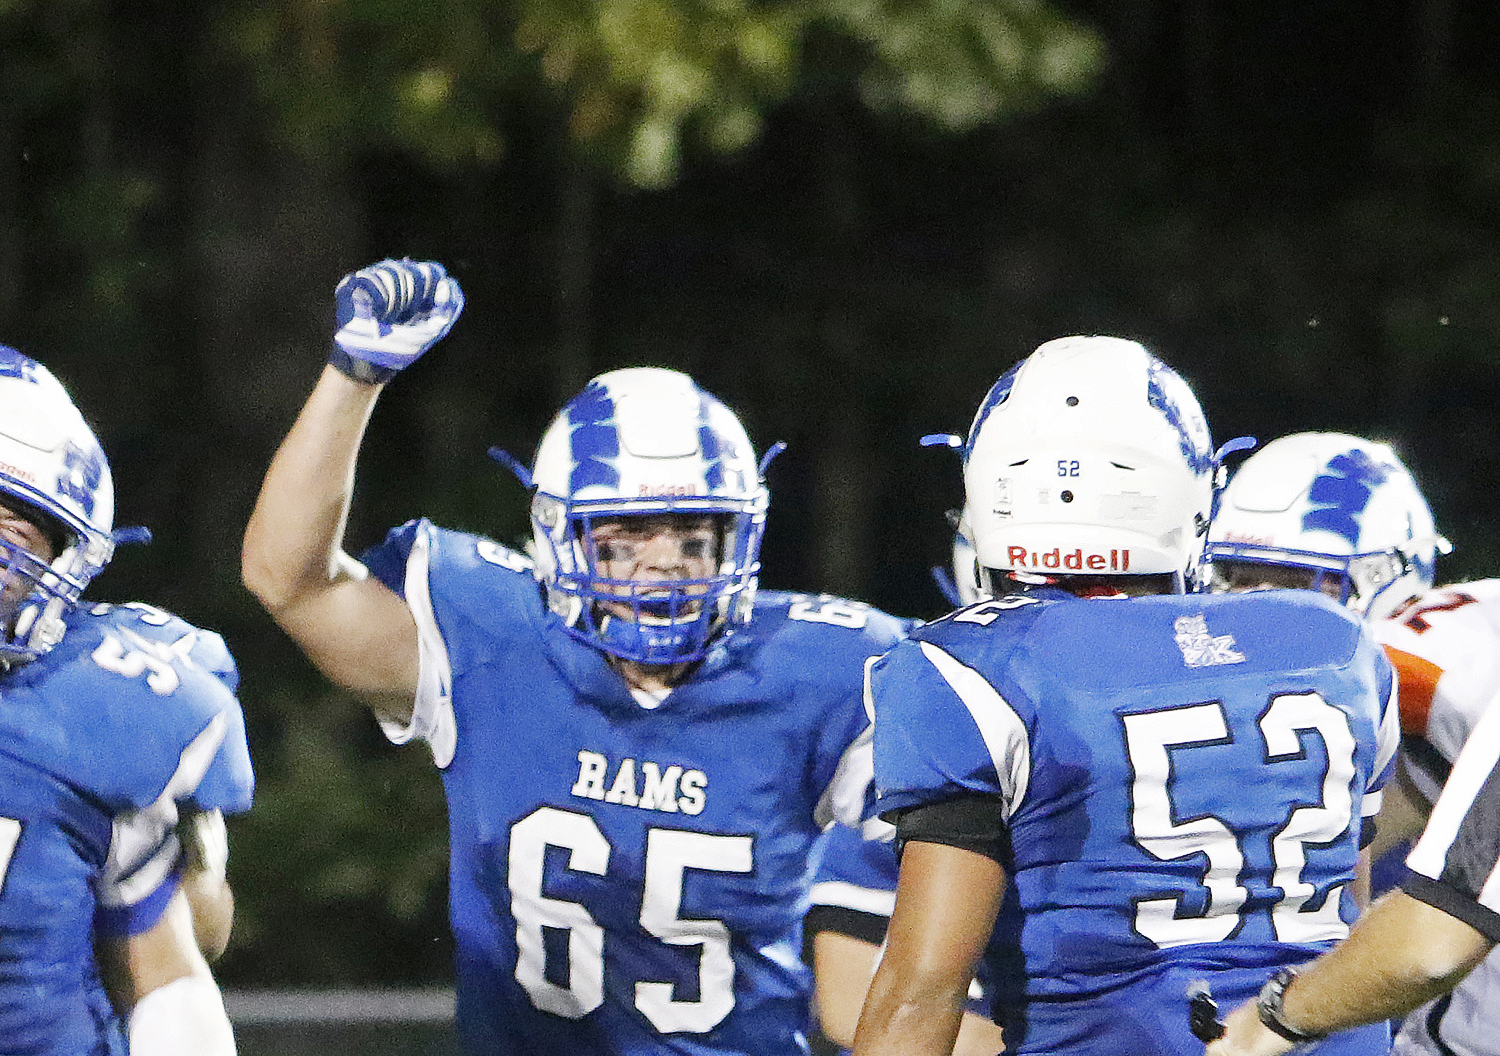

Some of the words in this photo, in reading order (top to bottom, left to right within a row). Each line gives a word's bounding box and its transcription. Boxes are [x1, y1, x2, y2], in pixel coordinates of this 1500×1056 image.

[1057, 460, 1080, 477] 52
[1007, 545, 1130, 572] Riddell
[571, 750, 708, 815] RAMS
[1115, 690, 1357, 950] 52
[508, 806, 753, 1034] 65
